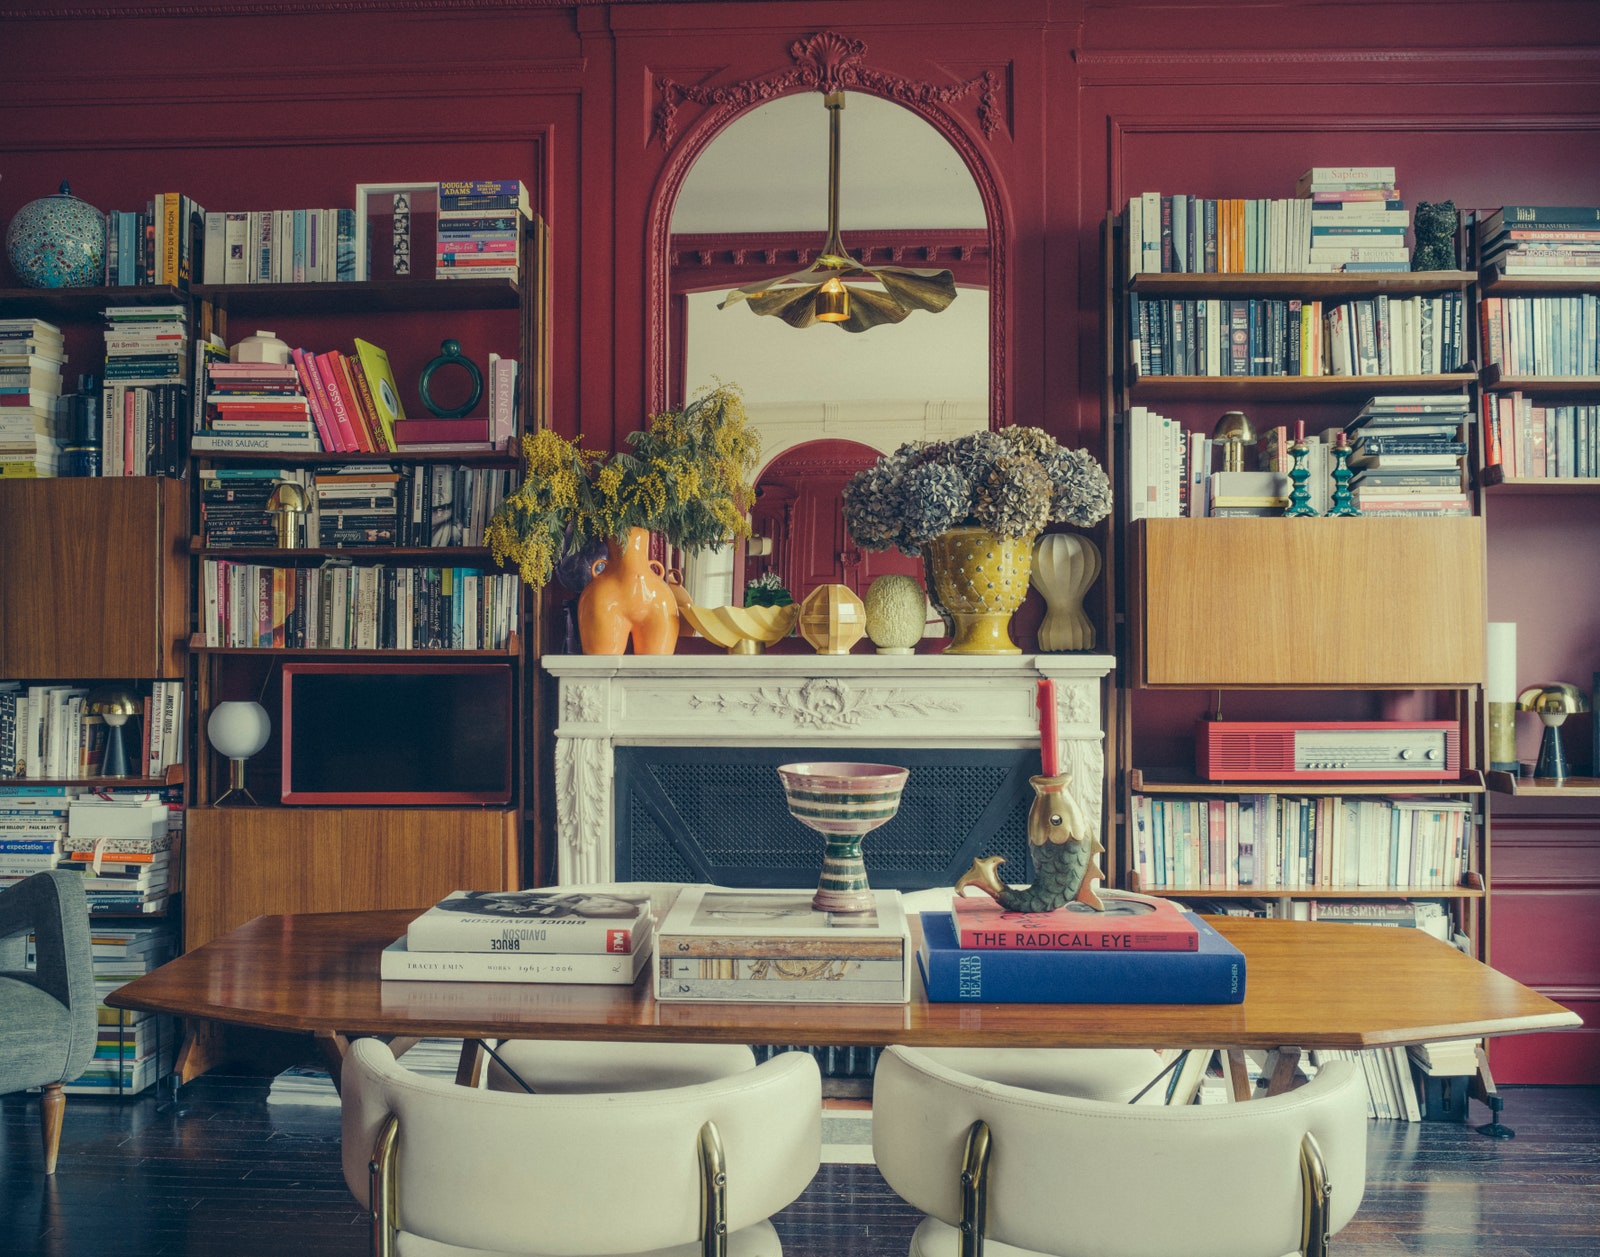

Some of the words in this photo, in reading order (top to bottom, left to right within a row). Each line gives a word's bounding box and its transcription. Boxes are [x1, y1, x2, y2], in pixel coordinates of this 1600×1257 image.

[1332, 170, 1368, 178] Sapiens
[168, 241, 174, 250] DE
[328, 383, 346, 422] PICASSO
[500, 369, 510, 425] HOCKNEY
[235, 440, 269, 448] SAUVAGE
[260, 577, 269, 600] cloud
[1320, 906, 1349, 917] ZADIE
[1352, 906, 1386, 917] SMITH
[502, 928, 546, 941] DAVIDSON
[972, 933, 1006, 946] THE
[1016, 933, 1093, 947] RADICAL
[1101, 934, 1132, 948] EYE
[490, 939, 520, 950] BRUCE
[678, 943, 690, 952] 3
[960, 956, 971, 998] PETER
[970, 955, 981, 998] BEARD
[679, 985, 690, 993] 2
